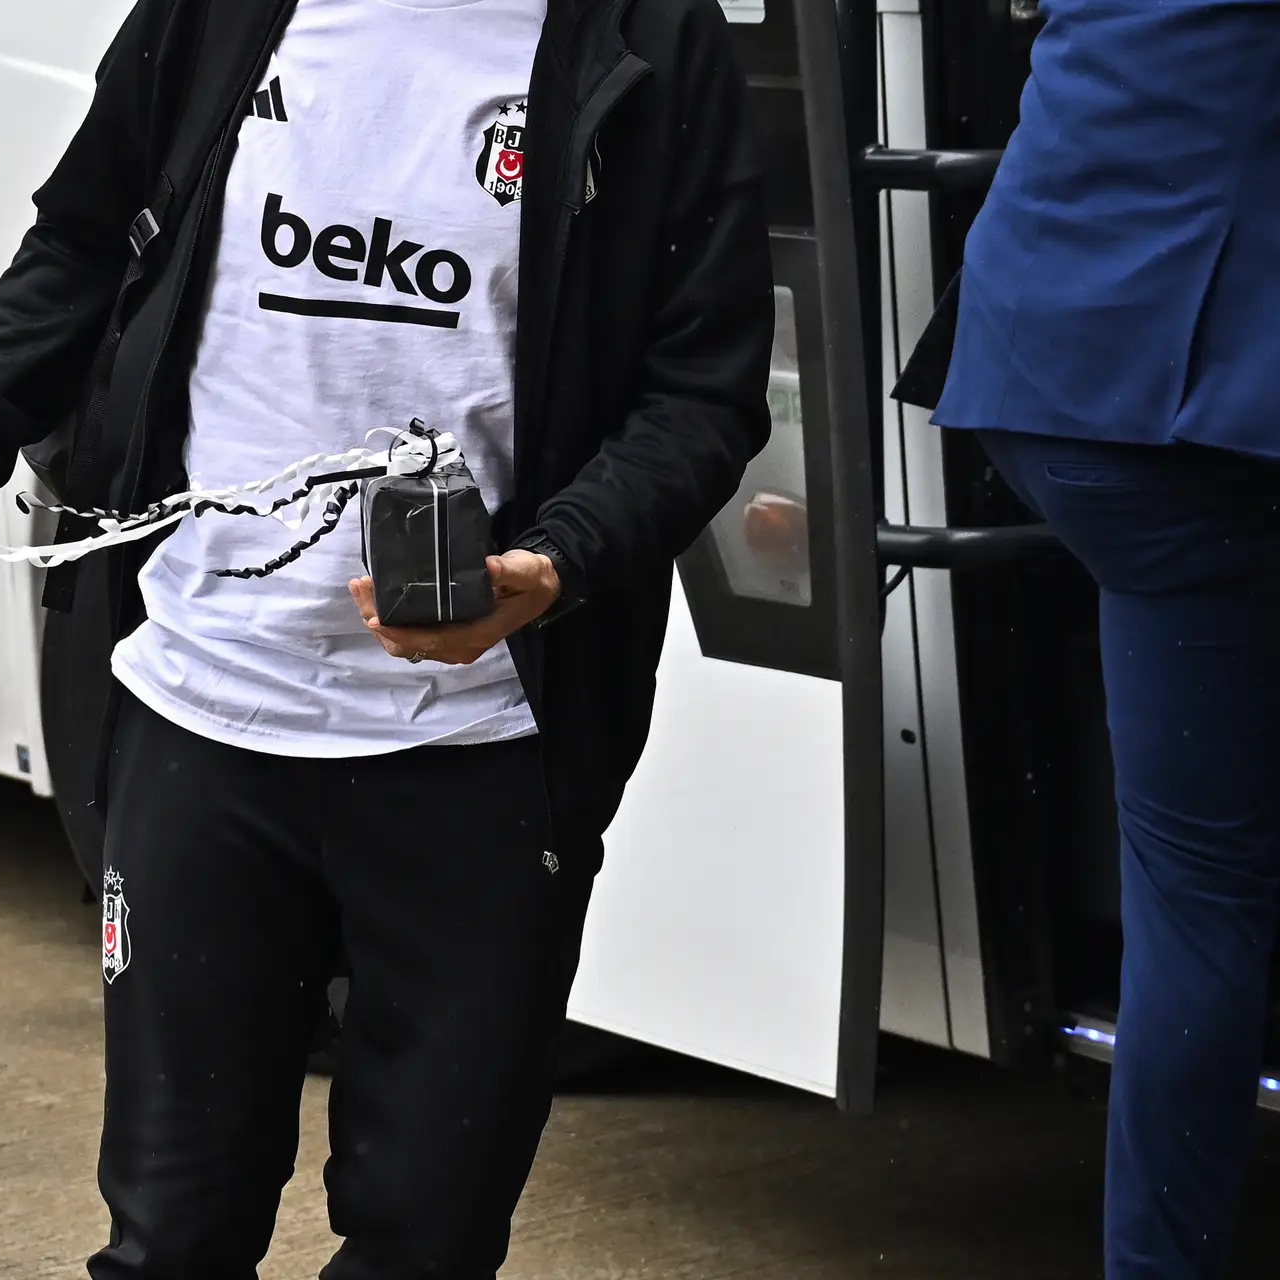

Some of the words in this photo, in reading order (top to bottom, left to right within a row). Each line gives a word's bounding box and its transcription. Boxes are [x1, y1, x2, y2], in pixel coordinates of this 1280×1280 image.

[494, 128, 522, 148] BJ
[261, 192, 472, 304] beko
[103, 957, 121, 969] 903
